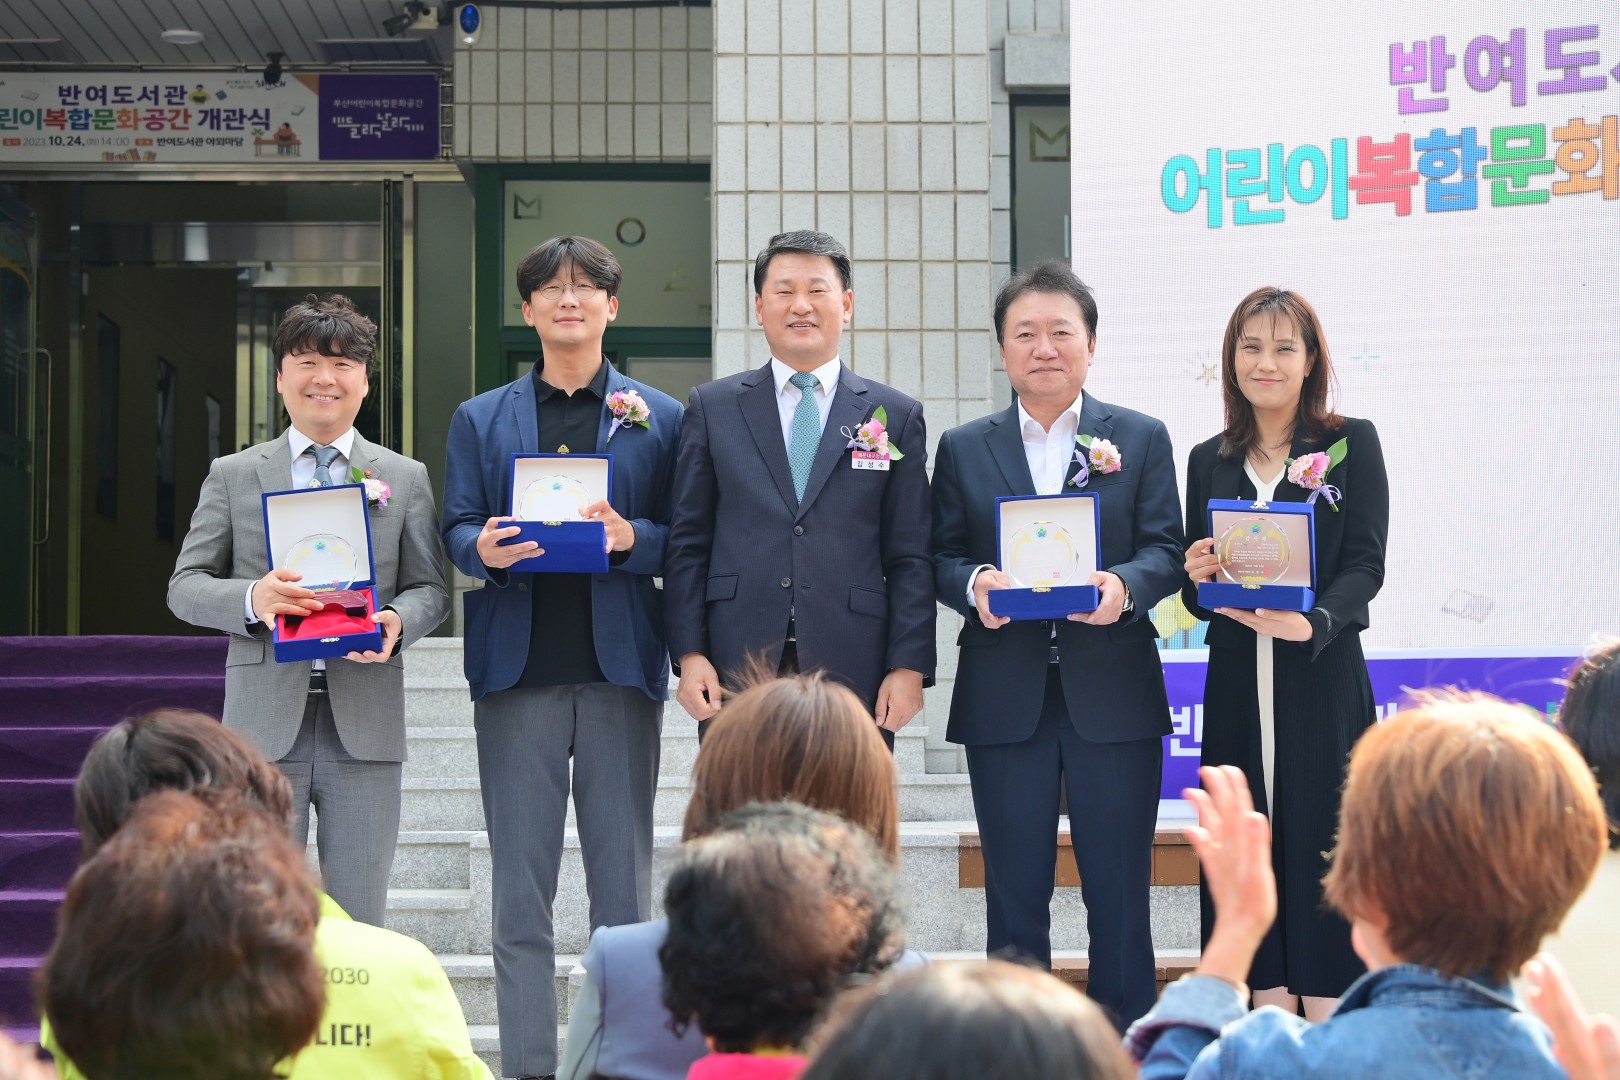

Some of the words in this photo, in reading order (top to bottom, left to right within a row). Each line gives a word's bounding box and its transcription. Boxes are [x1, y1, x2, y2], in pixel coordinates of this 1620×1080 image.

[58, 84, 188, 106] 반여도서관
[198, 108, 271, 131] 개관식
[157, 137, 204, 147] 반여도서관
[206, 137, 244, 147] 야외마당
